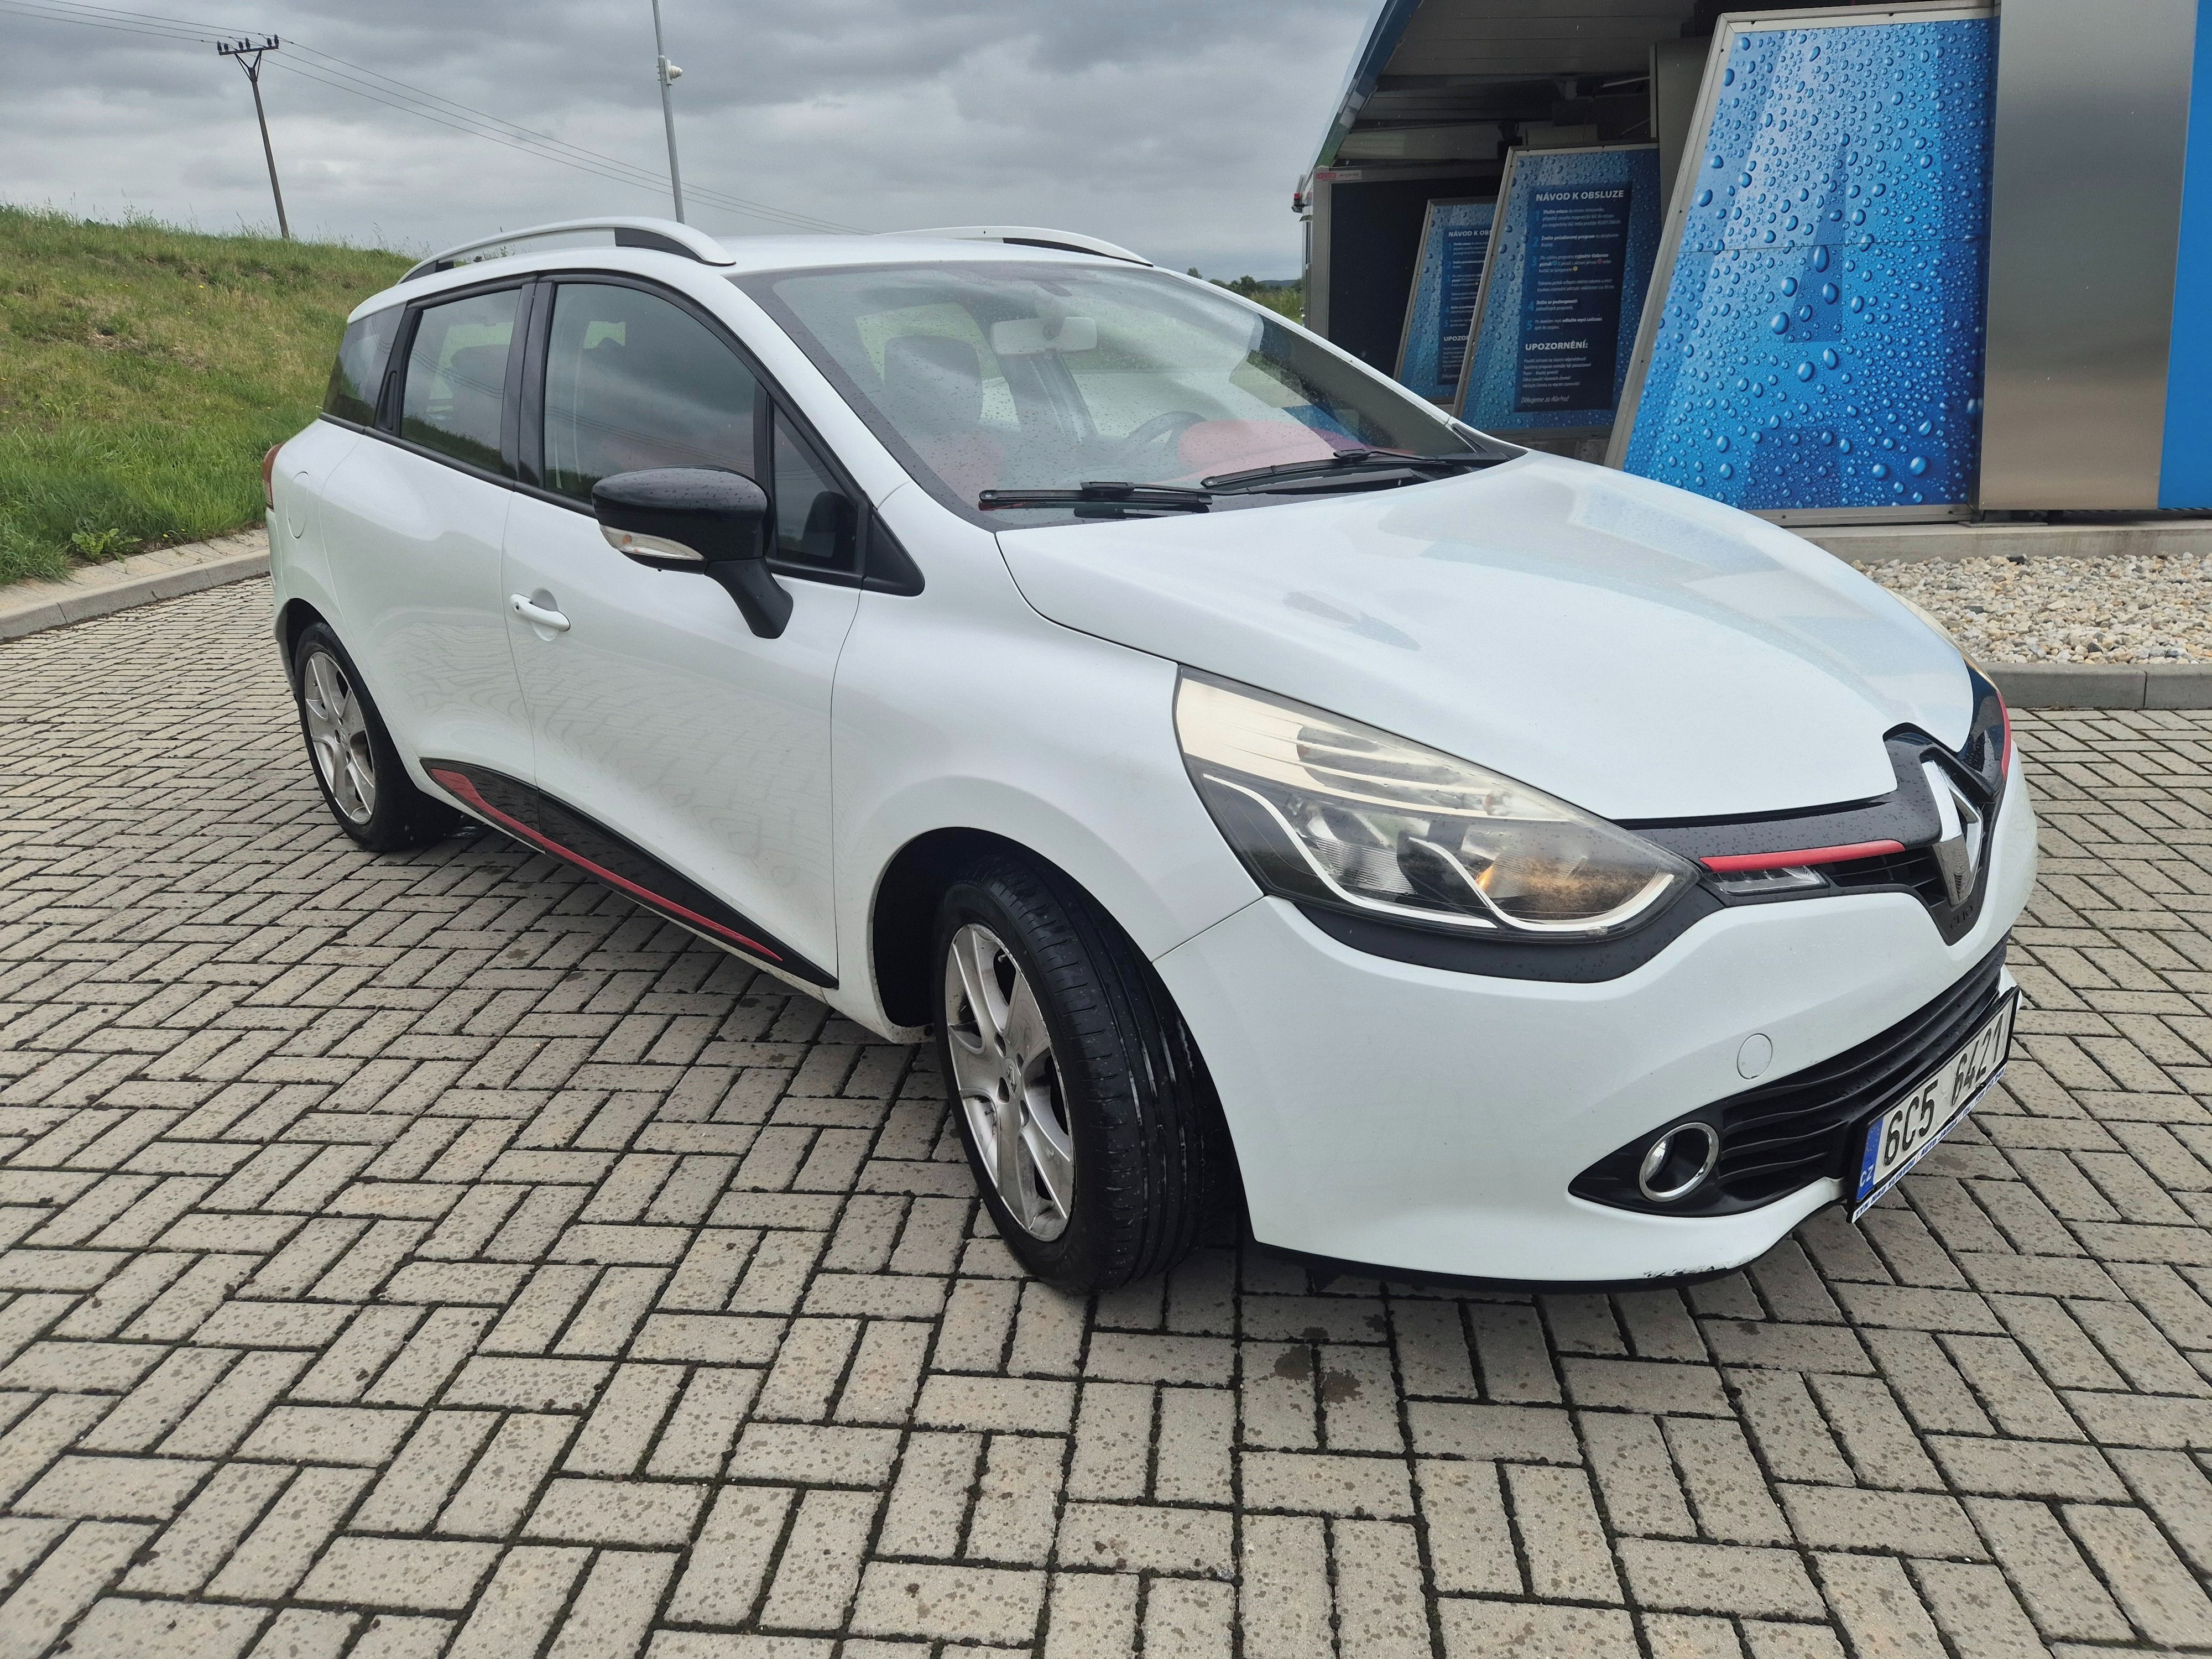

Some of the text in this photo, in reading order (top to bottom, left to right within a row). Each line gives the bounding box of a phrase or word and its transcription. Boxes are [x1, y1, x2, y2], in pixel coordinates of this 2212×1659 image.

[1536, 192, 1571, 201] NÁVOD
[1580, 190, 1624, 200] OBSLUZE
[1528, 301, 1534, 311] 4
[1527, 320, 1532, 330] 5
[1525, 338, 1588, 351] UPOZORNĚNÍ:
[1950, 905, 1973, 930] CLIO
[1884, 1079, 1938, 1166] 6C5
[1952, 1013, 2004, 1105] 6421
[1860, 1164, 1874, 1187] CZ
